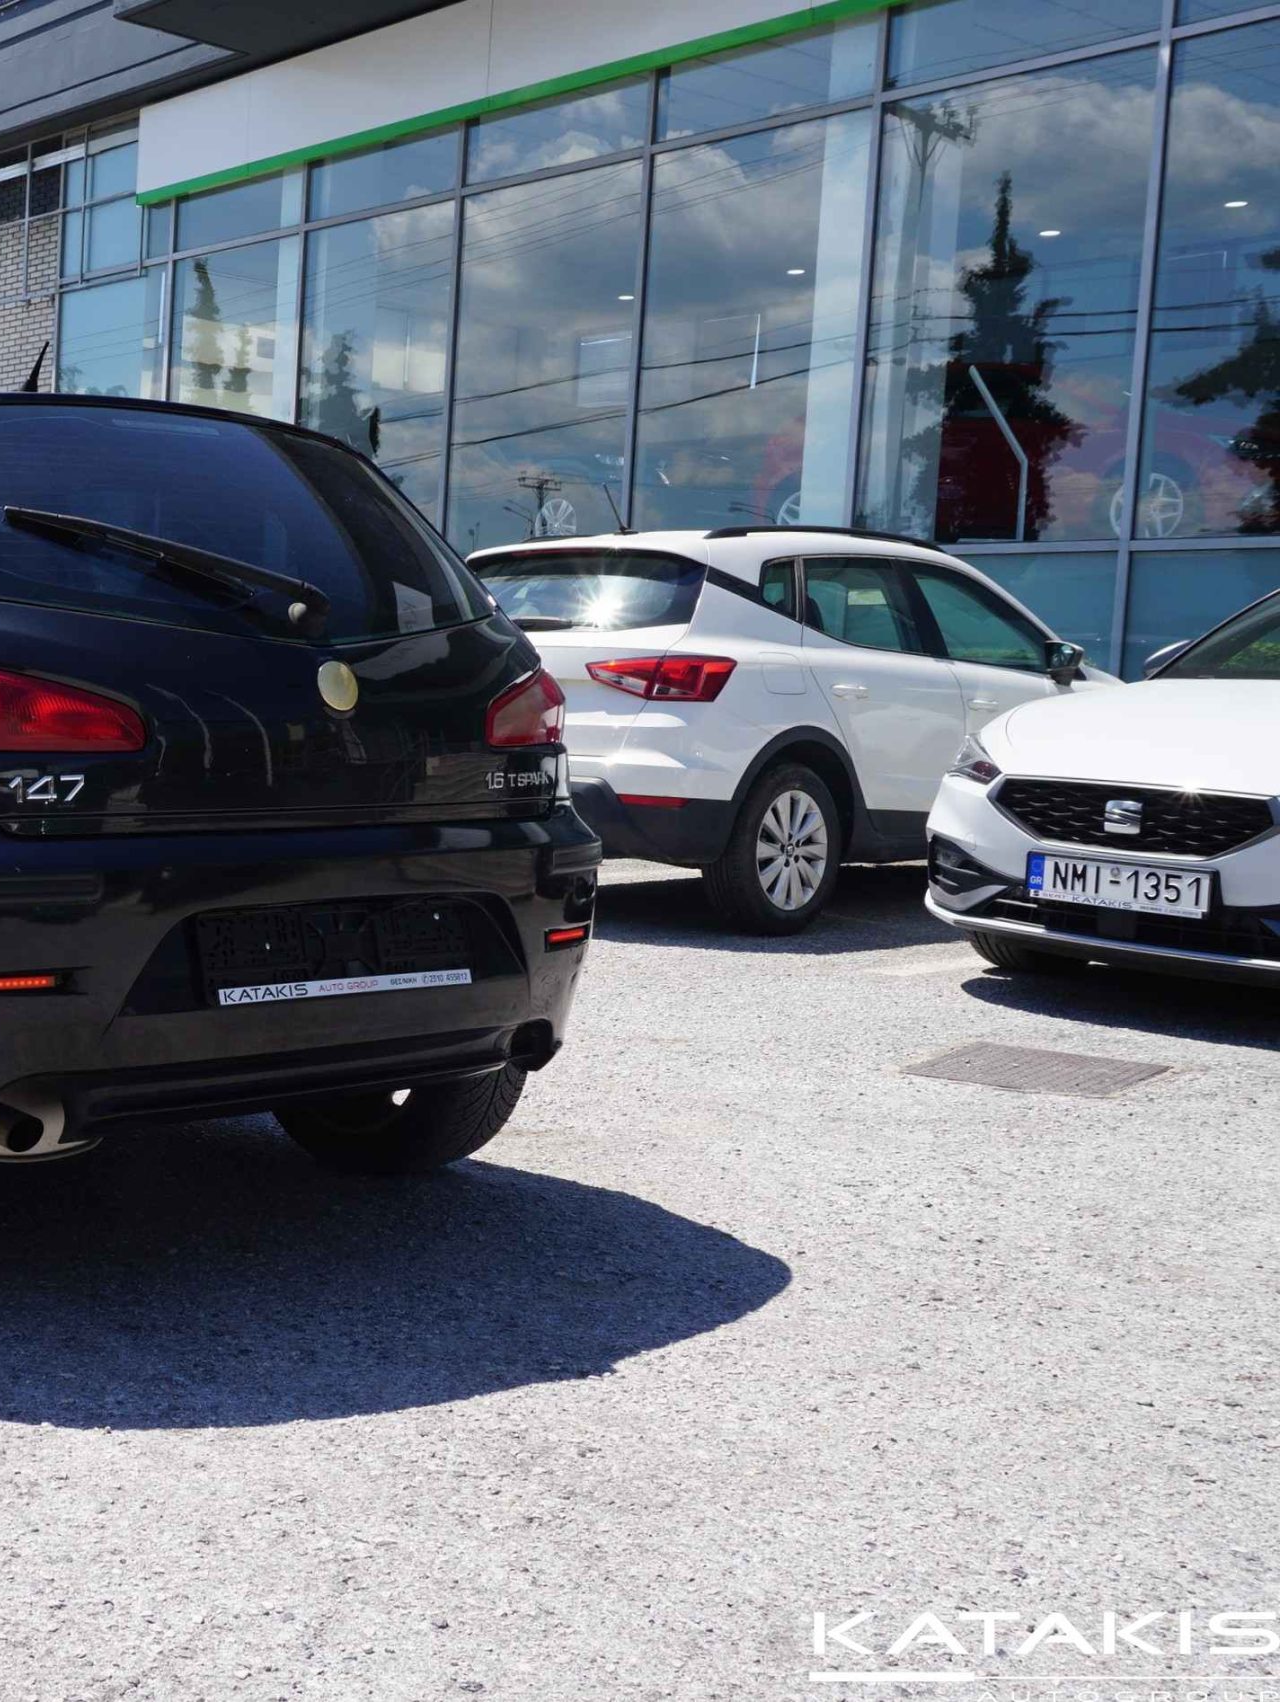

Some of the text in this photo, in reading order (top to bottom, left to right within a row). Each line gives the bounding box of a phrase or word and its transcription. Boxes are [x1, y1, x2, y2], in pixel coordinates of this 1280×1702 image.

[9, 774, 85, 803] 147
[1030, 876, 1042, 884] GR
[1072, 896, 1133, 909] KATAKIS
[223, 980, 379, 1003] KATAKIS AUTO GROUP
